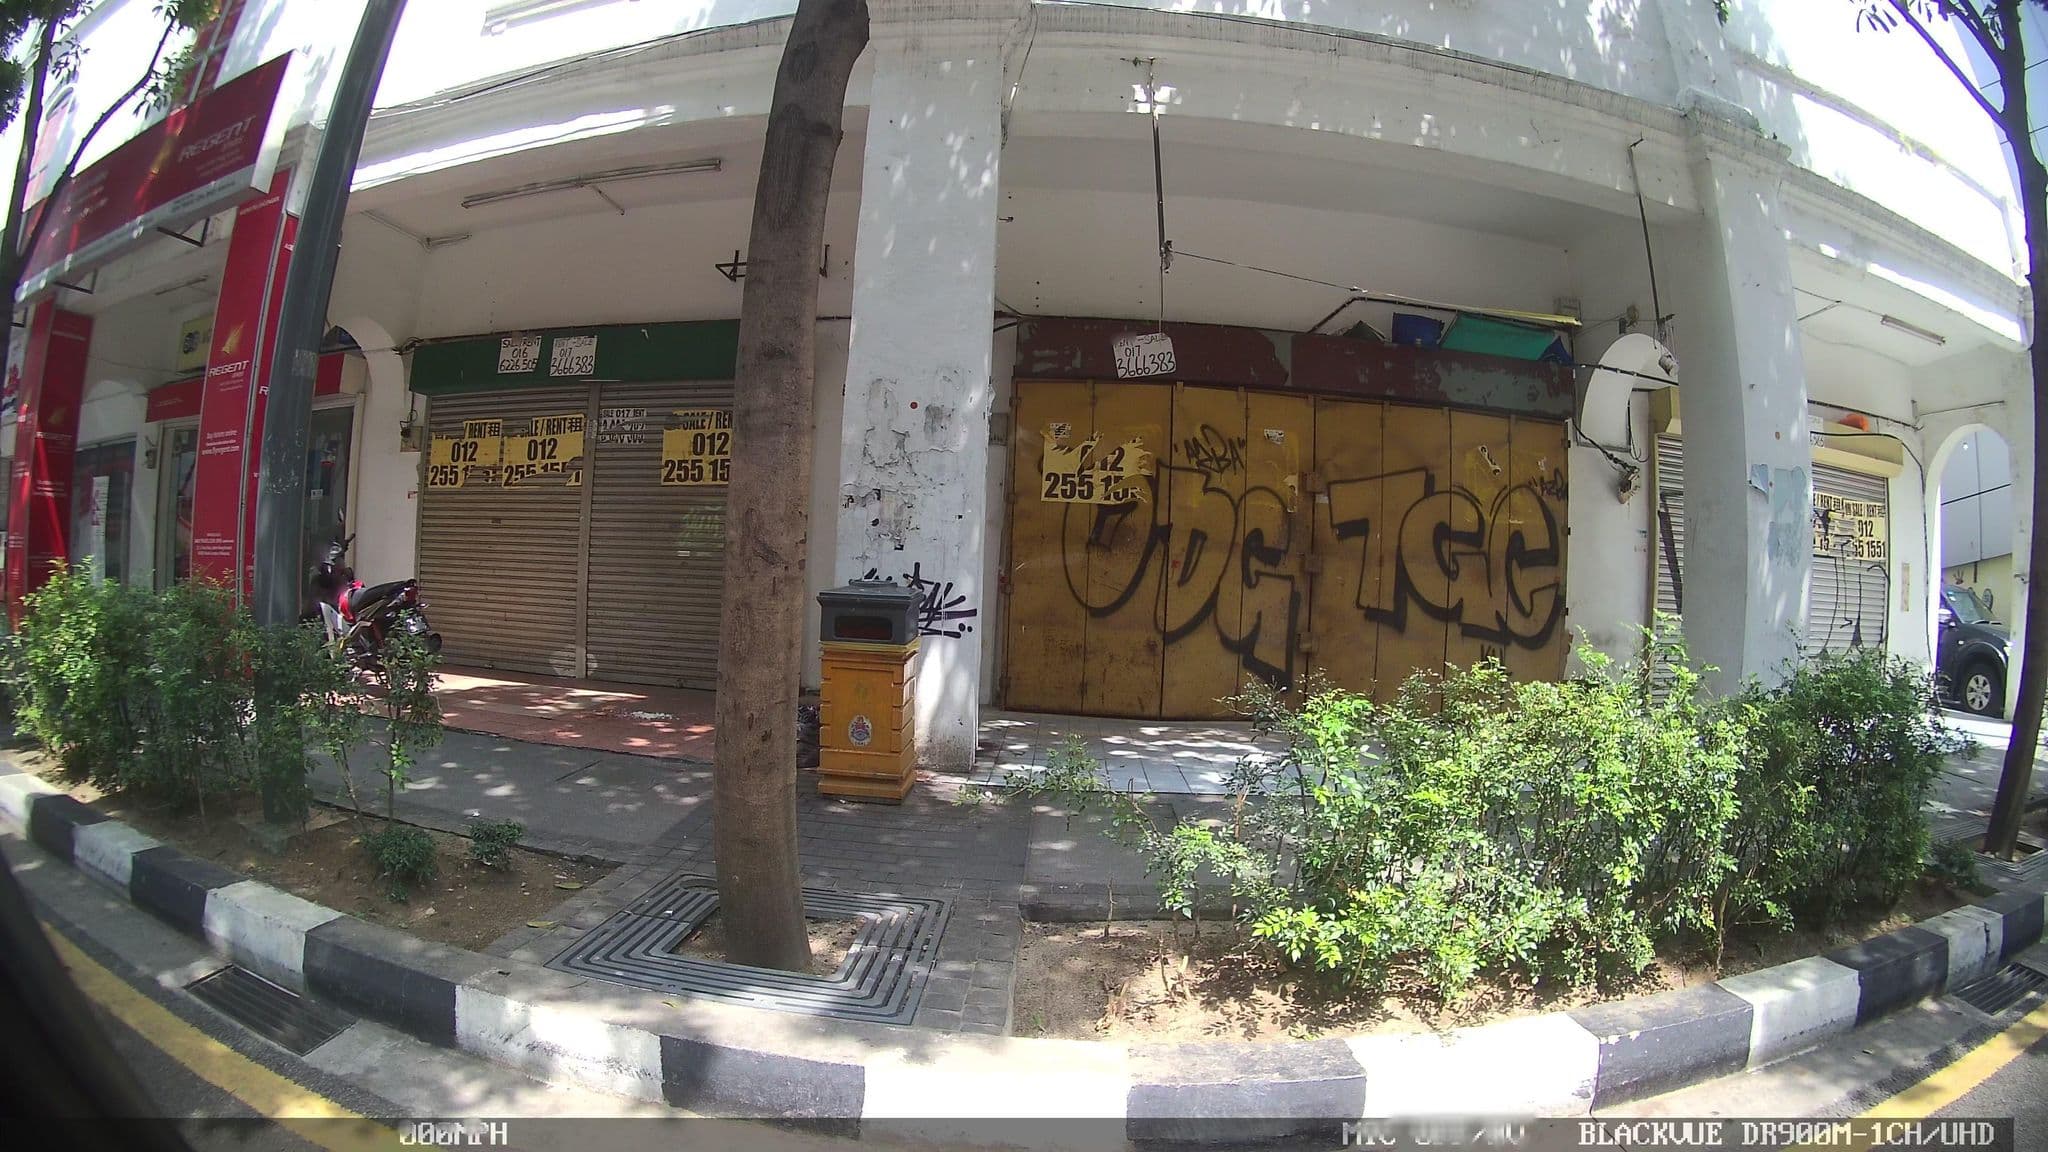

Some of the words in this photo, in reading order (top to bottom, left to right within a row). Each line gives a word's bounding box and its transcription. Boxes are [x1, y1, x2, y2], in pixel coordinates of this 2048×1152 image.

[178, 115, 257, 162] REGENT
[511, 347, 528, 358] 016
[560, 347, 573, 358] 017
[1125, 345, 1141, 358] 017
[208, 360, 250, 377] REGENT
[551, 356, 594, 376] 3666383
[1116, 352, 1176, 378] 3666383
[615, 409, 631, 418] 017
[468, 422, 487, 438] RENT
[546, 417, 568, 435] RENT
[451, 441, 479, 463] 012
[527, 437, 559, 461] 012
[692, 432, 730, 456] 012
[429, 465, 459, 487] 255
[663, 459, 704, 482] 255
[1044, 472, 1094, 500] 255
[1866, 540, 1886, 559] 1551
